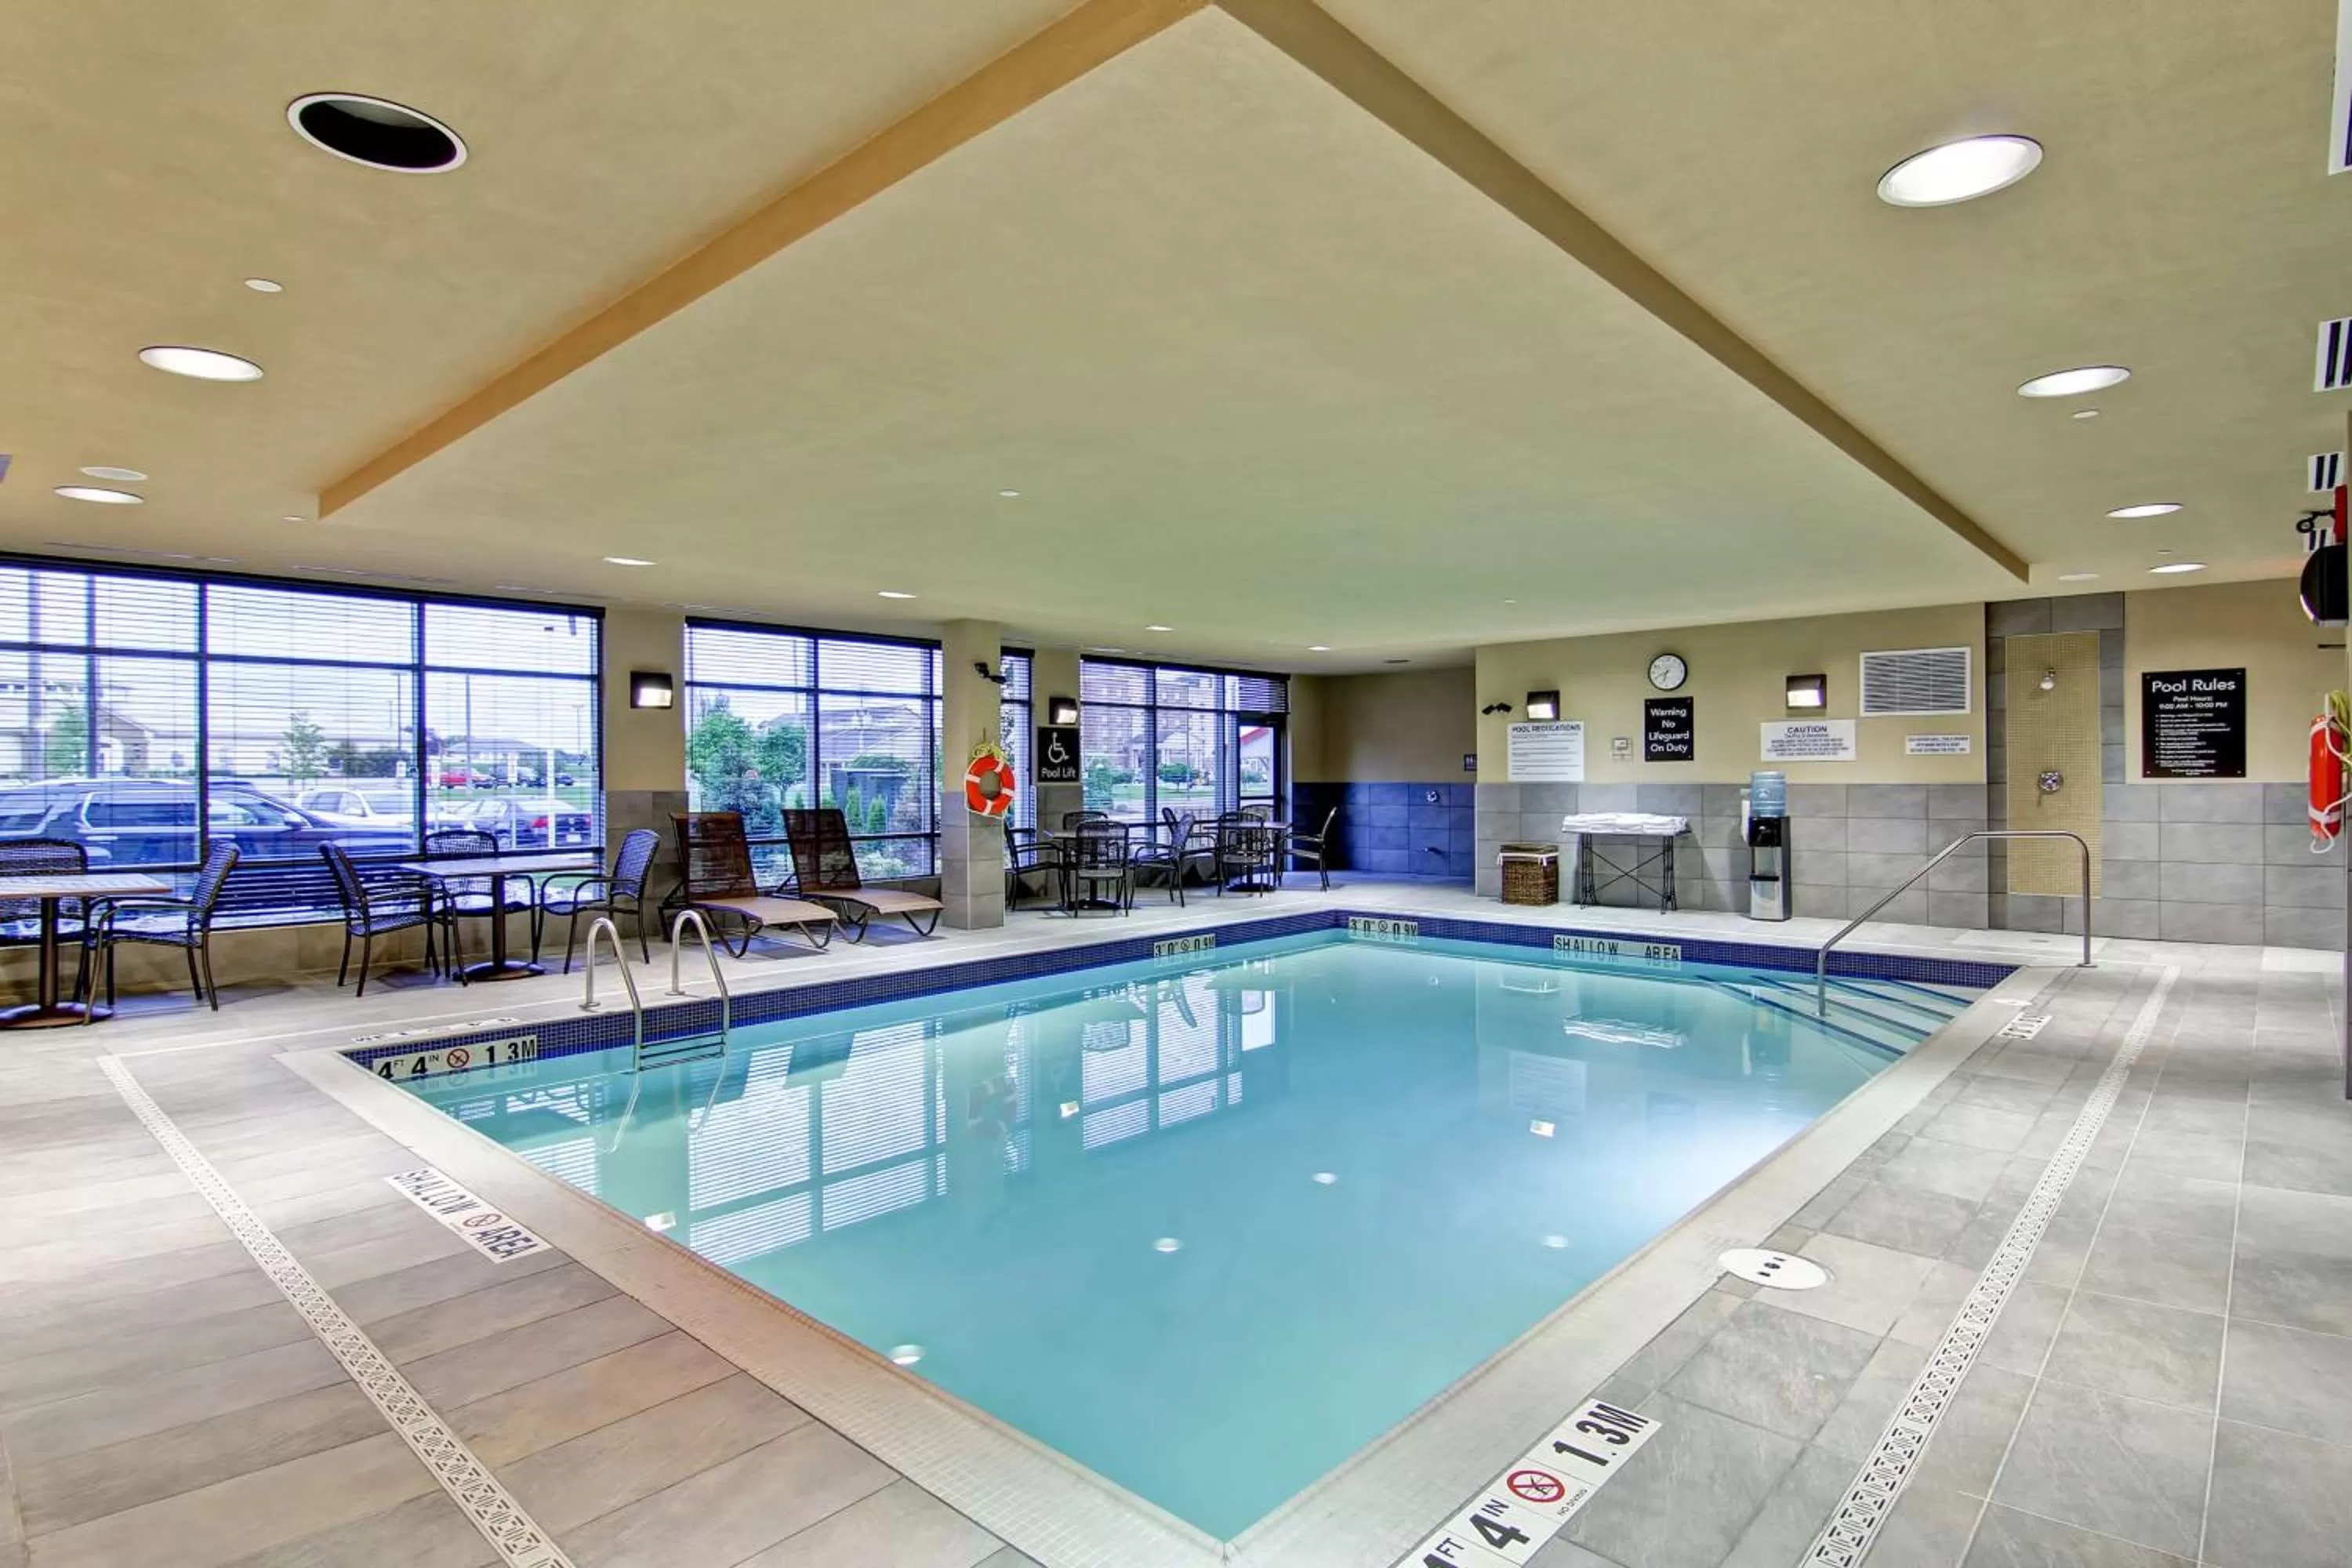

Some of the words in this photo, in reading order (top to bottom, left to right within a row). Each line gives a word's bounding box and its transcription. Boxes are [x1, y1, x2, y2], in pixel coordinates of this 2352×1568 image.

[2152, 679, 2187, 693] Pool
[2192, 677, 2236, 691] Rules
[1650, 707, 1687, 717] Warning
[1787, 724, 1828, 734] CAUTION
[1649, 731, 1690, 742] Lifeguard
[1650, 743, 1664, 752] On
[1666, 742, 1688, 753] Duty
[1041, 767, 1061, 778] Pool
[1062, 766, 1076, 778] Lift
[1555, 937, 1619, 956] SHALLOW
[1645, 945, 1679, 961] AREA
[393, 1168, 481, 1215] SHALLOW
[470, 1225, 539, 1259] AREA
[1552, 1403, 1650, 1467] 1.3M
[1556, 1506, 1570, 1516] NO
